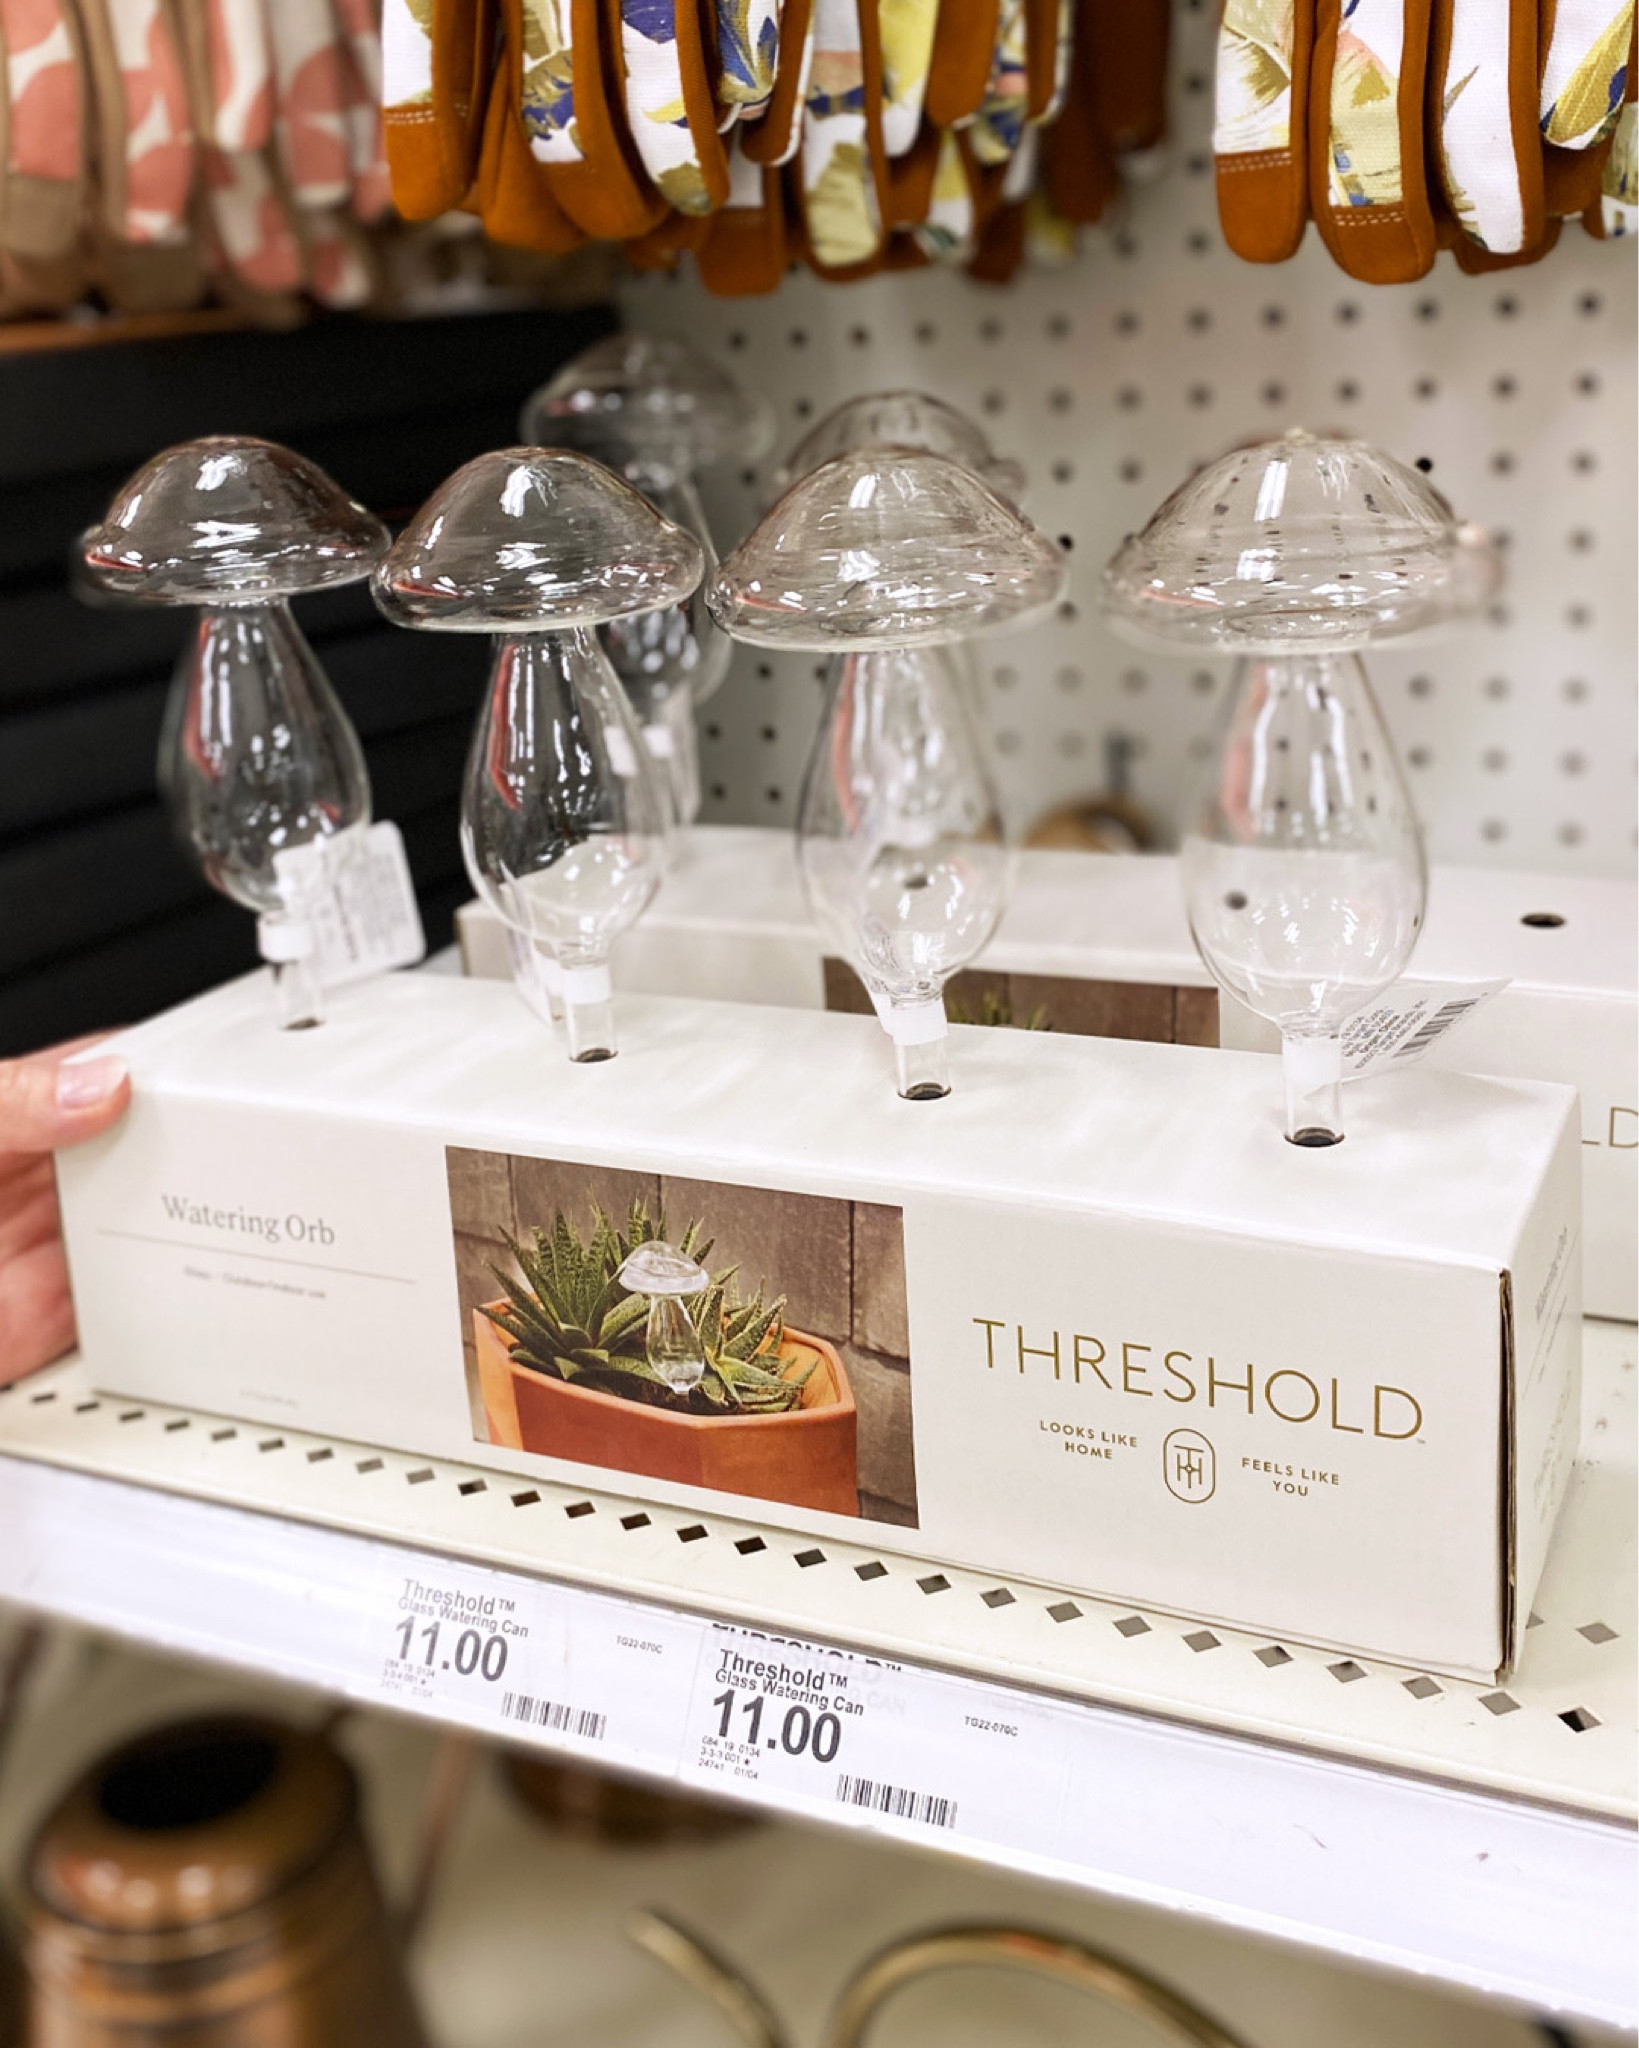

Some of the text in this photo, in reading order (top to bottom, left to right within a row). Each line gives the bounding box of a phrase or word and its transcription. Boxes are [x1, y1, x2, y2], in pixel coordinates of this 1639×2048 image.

[161, 1194, 336, 1246] Watering Orb
[972, 1317, 1424, 1441] THRESHOLD
[1040, 1419, 1138, 1449] LOOKS LIKE
[1064, 1441, 1113, 1460] HOME
[1241, 1457, 1340, 1486] FEELS LIKE
[1272, 1480, 1309, 1497] YOU
[399, 1596, 529, 1638] Glass Watering Can
[396, 1615, 508, 1682] 11.00
[715, 1668, 864, 1716] Glass Watering Can
[713, 1689, 842, 1763] 11.00
